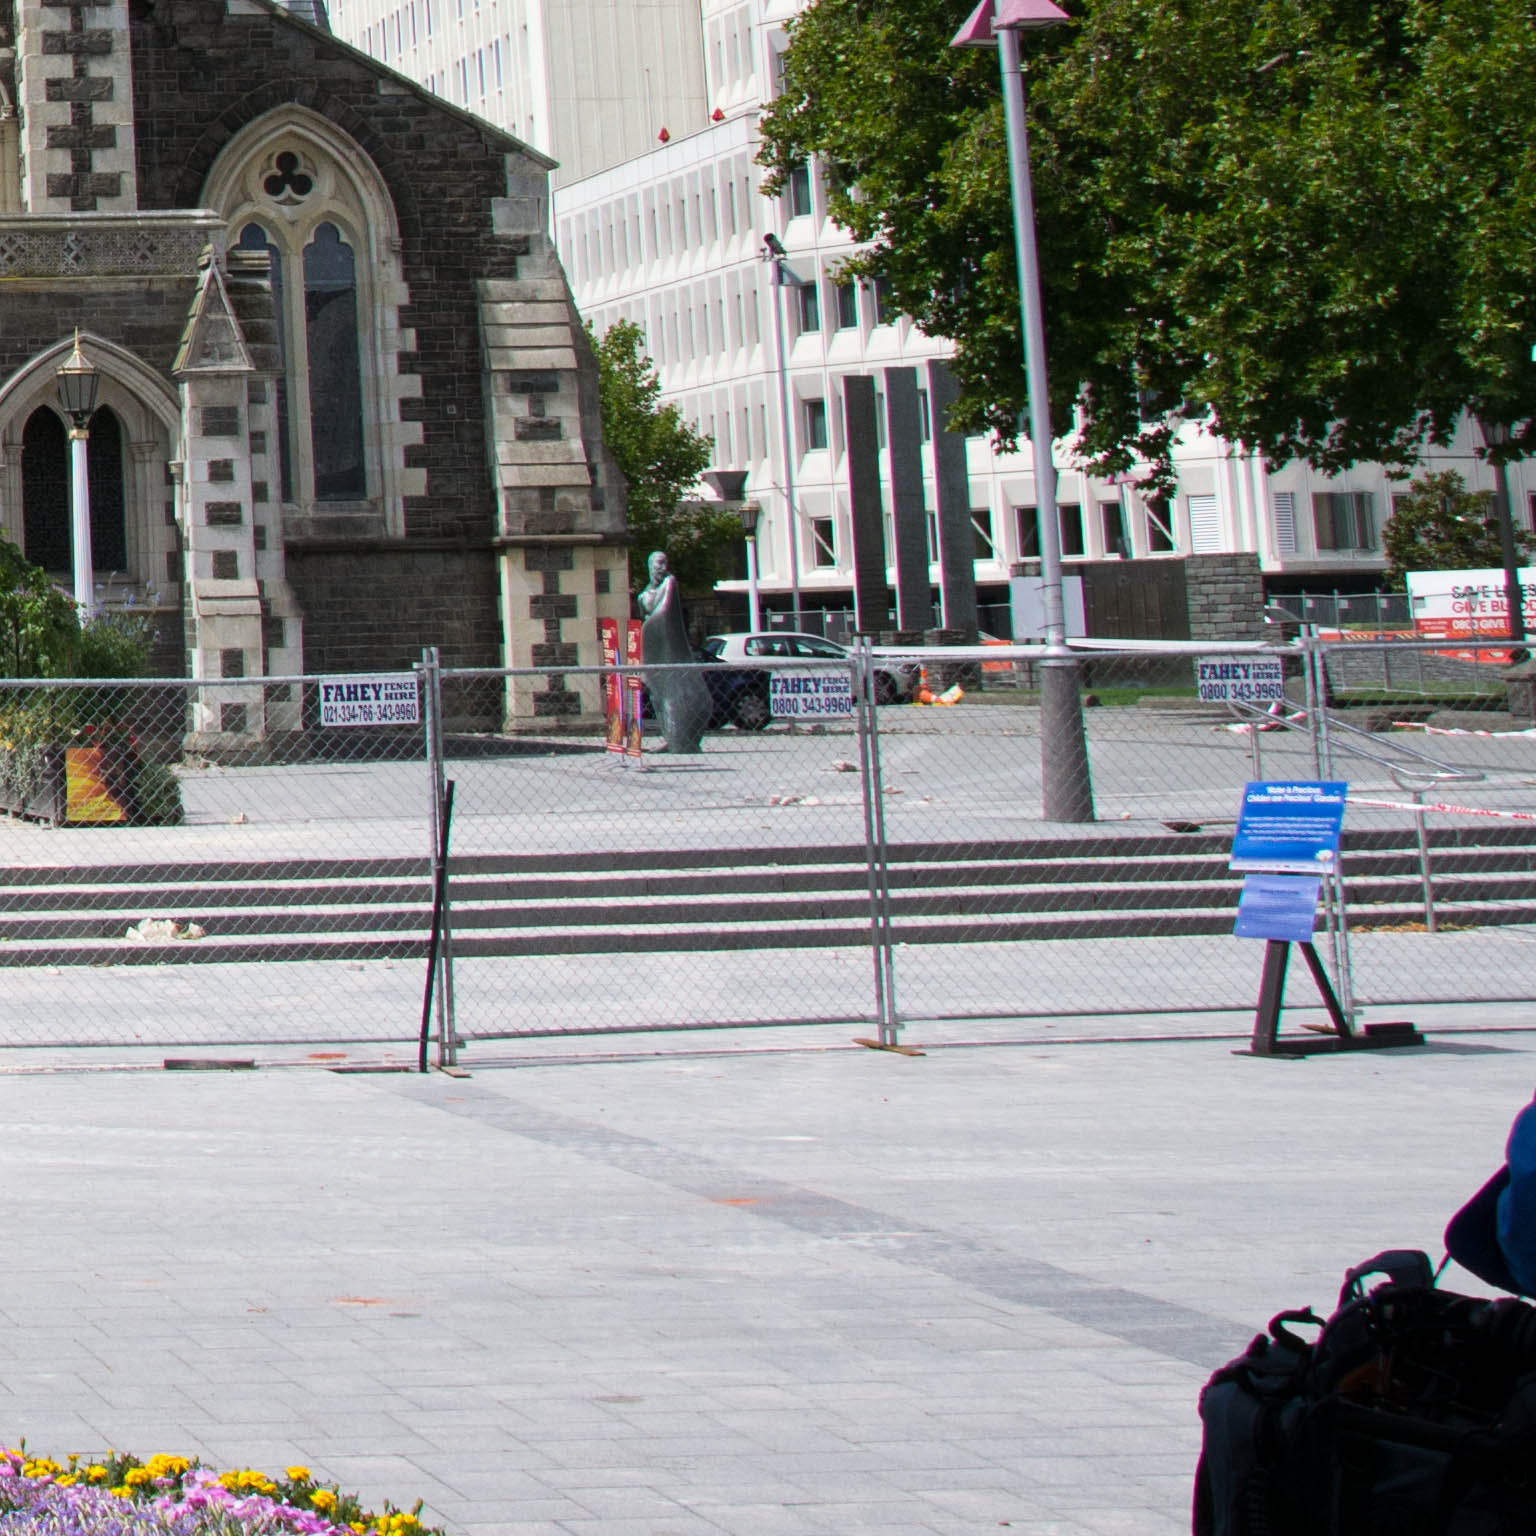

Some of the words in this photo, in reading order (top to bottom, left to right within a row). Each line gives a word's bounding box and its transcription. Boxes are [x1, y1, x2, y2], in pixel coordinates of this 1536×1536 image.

[1200, 664, 1250, 680] FAHEY
[323, 683, 382, 702] FAHEY
[384, 682, 416, 690] FENCE
[772, 677, 821, 694] FAHEY
[384, 692, 416, 700] HIRE
[772, 698, 798, 714] 0800
[802, 697, 851, 713] 343-9960
